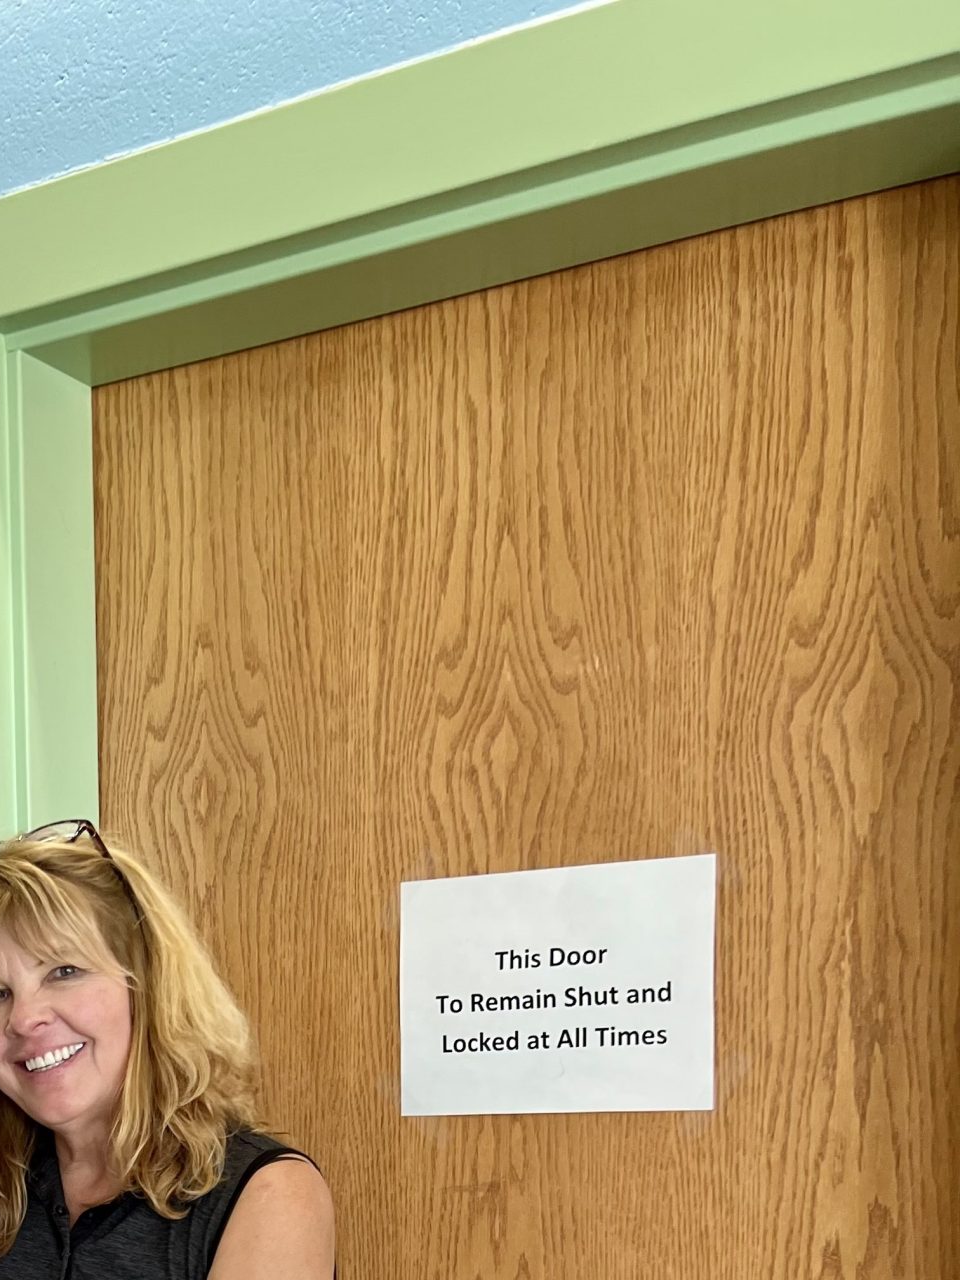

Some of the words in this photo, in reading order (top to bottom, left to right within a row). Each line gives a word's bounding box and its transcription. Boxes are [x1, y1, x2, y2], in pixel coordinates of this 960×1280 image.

[494, 948, 541, 971] This
[549, 947, 608, 967] Door
[435, 995, 463, 1014] To
[470, 988, 557, 1013] Remain
[564, 985, 619, 1008] Shut
[626, 980, 672, 1004] and
[442, 1030, 519, 1054] Locked
[527, 1031, 550, 1050] at
[556, 1026, 587, 1049] All
[594, 1026, 668, 1047] Times
